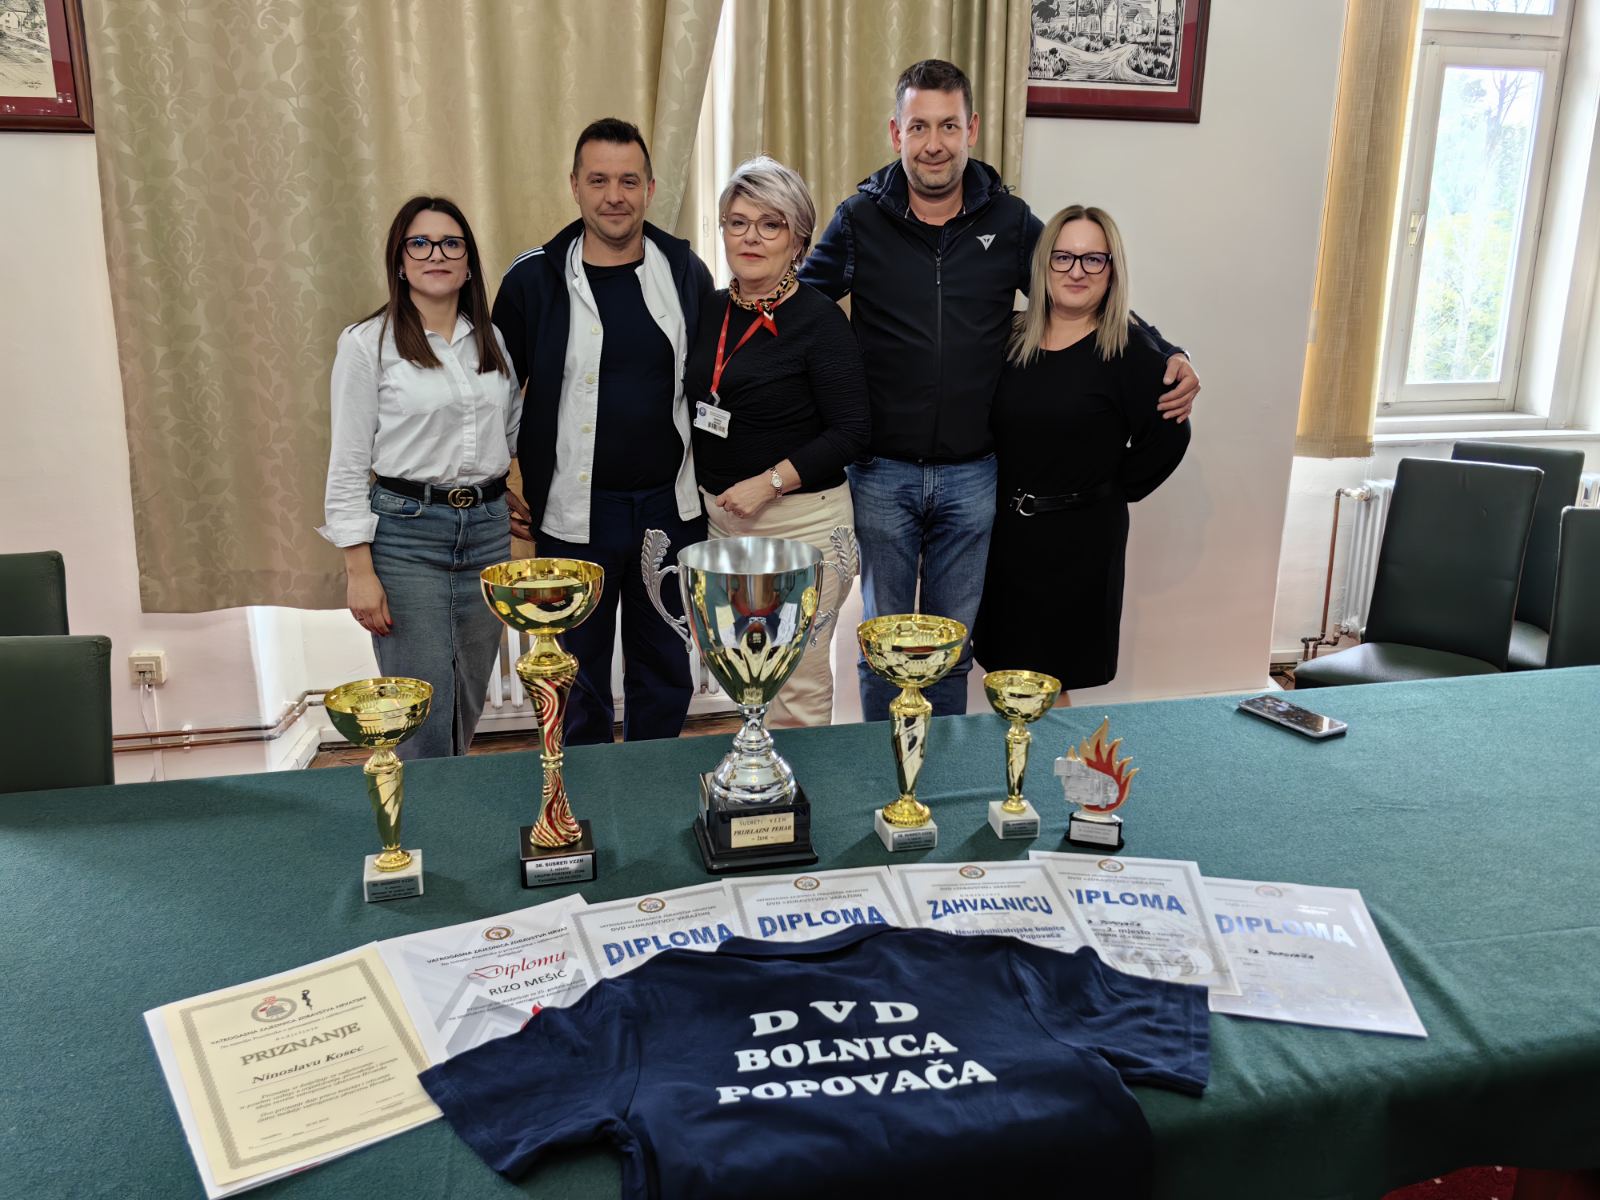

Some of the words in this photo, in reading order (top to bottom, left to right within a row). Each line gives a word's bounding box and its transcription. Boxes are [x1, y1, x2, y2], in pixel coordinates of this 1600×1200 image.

[926, 896, 1053, 920] ZAHVALNICU
[1068, 888, 1187, 915] IPLOMA
[757, 905, 888, 938] DIPLOMA
[1214, 914, 1357, 948] DIPLOMA
[602, 923, 735, 967] DIPLOMA
[467, 951, 568, 980] Diplomu
[488, 982, 520, 996] RIZO
[524, 968, 568, 987] MEŠIĆ
[240, 1022, 361, 1066] PRIZNANJE
[734, 1032, 959, 1072] BOLNICA
[251, 1057, 321, 1084] Ninoslavu
[716, 1058, 998, 1105] POPOVAČA
